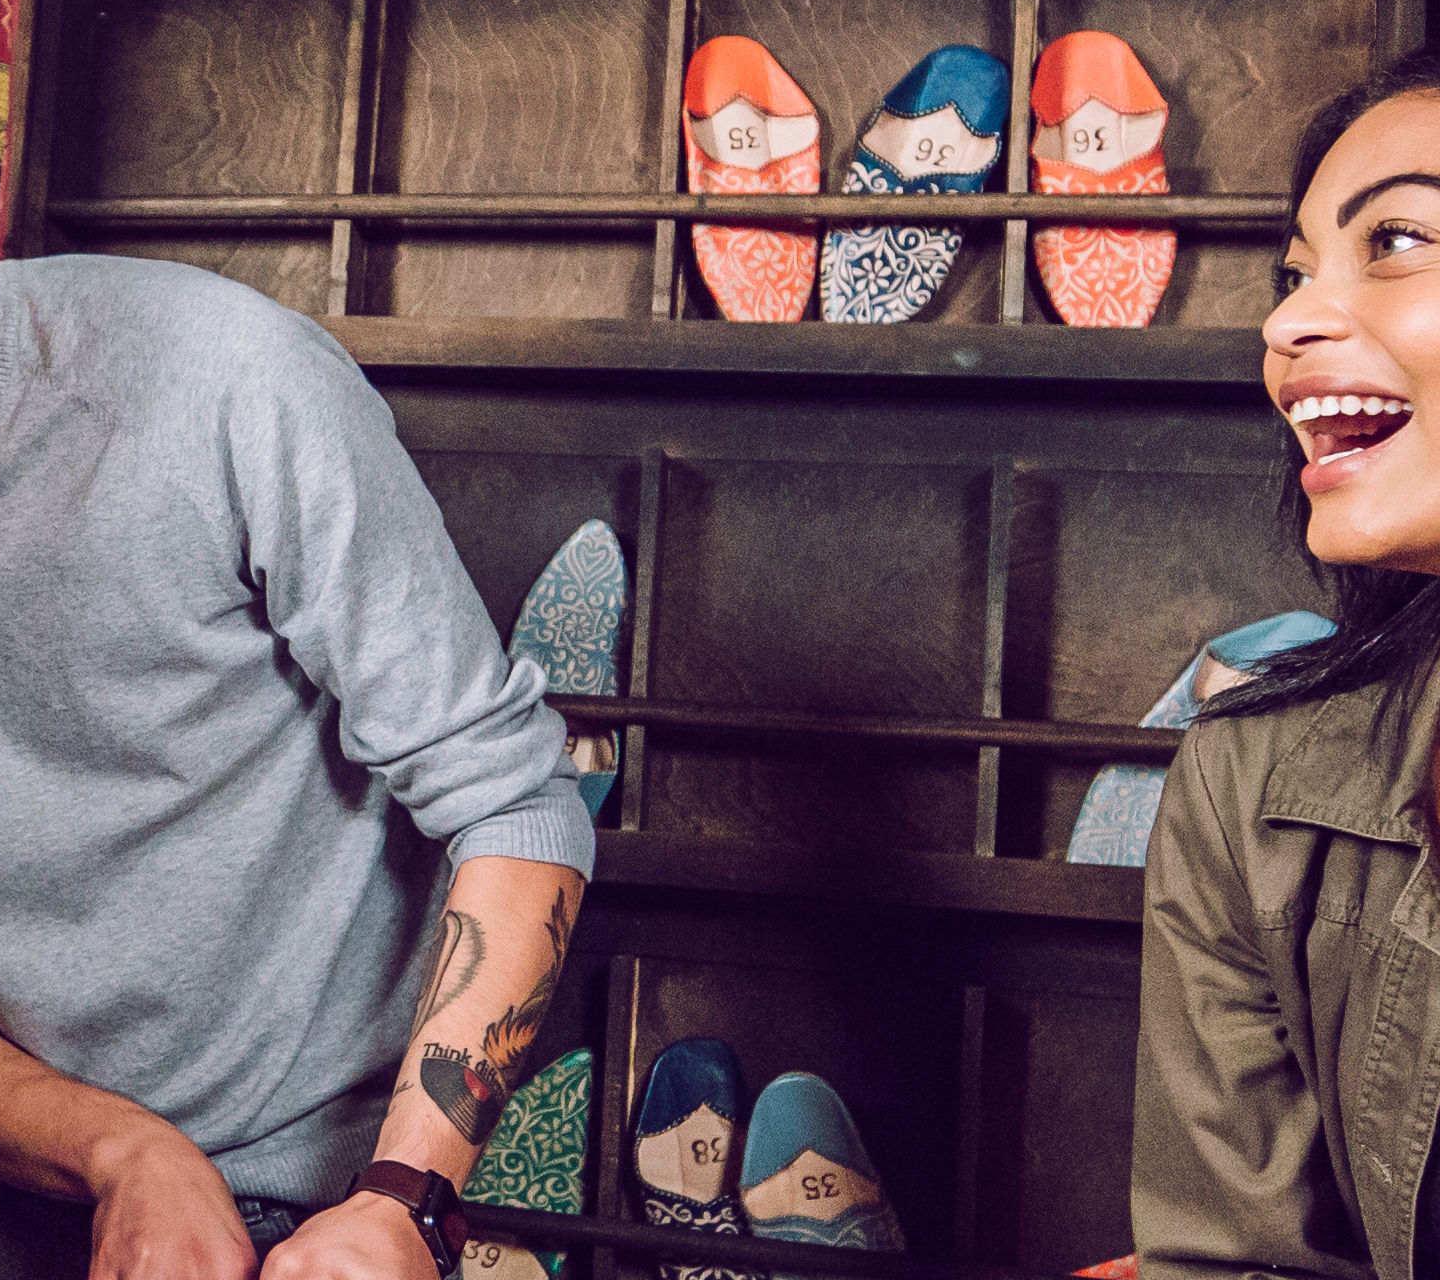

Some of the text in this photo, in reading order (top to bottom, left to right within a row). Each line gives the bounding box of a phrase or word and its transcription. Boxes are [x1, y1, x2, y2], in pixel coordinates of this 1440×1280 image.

[728, 126, 761, 152] 35
[915, 137, 956, 168] 36
[1073, 126, 1110, 154] 36
[423, 1042, 472, 1065] Think
[691, 1137, 726, 1165] 38
[801, 1173, 840, 1200] 35
[463, 1241, 501, 1268] 39
